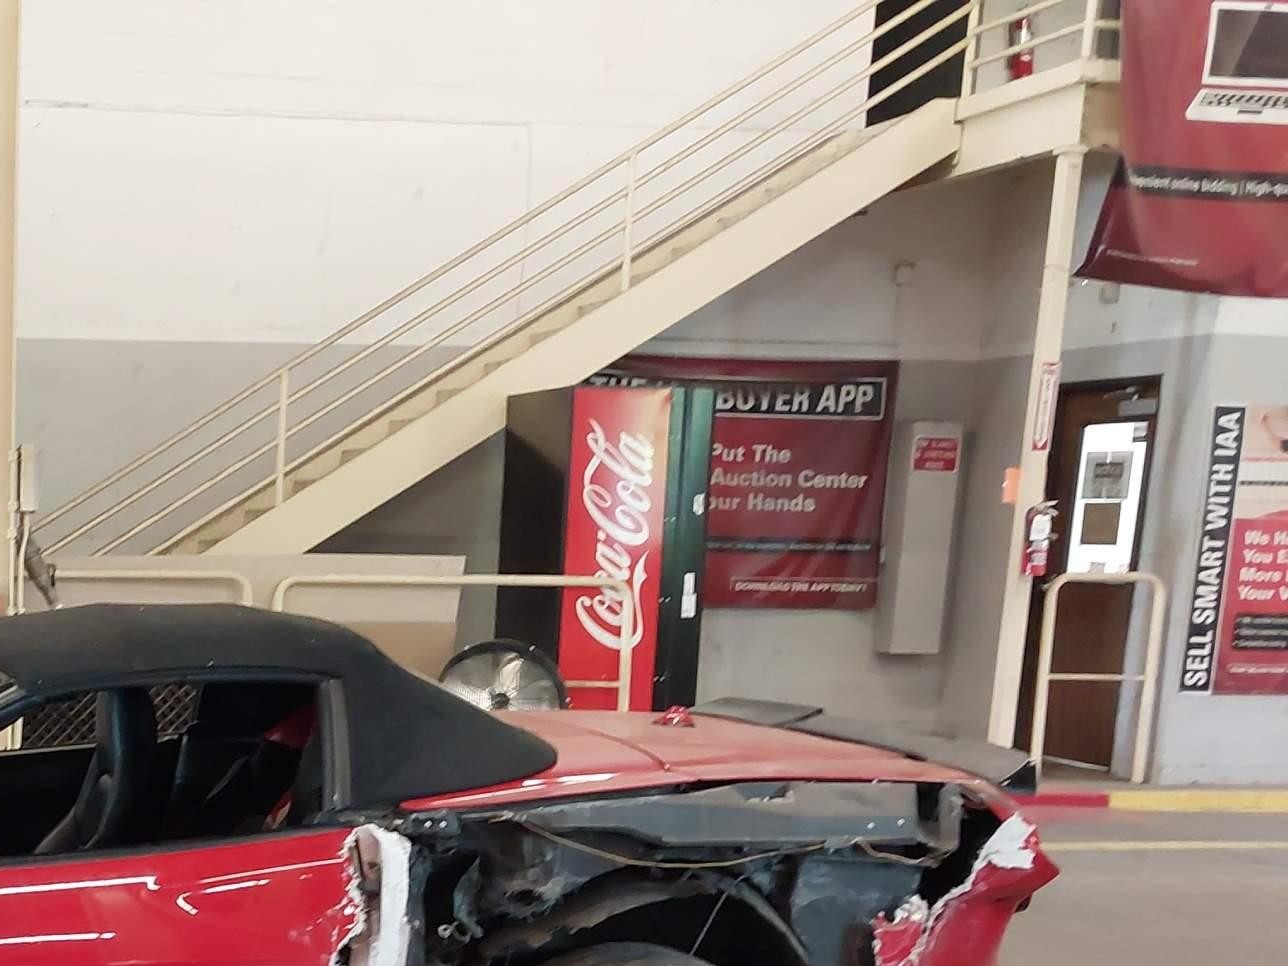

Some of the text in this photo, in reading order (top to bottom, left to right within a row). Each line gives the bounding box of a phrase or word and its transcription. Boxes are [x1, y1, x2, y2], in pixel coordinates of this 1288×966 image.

[715, 383, 874, 413] BUYER APP
[752, 444, 792, 464] The
[710, 468, 867, 489] Auction Center
[747, 493, 816, 513] Hands
[1244, 530, 1270, 545] We
[1184, 411, 1242, 688] SELL SMART WITH IAA
[1243, 549, 1273, 563] You
[1239, 567, 1283, 582] More
[1238, 585, 1275, 600] Your
